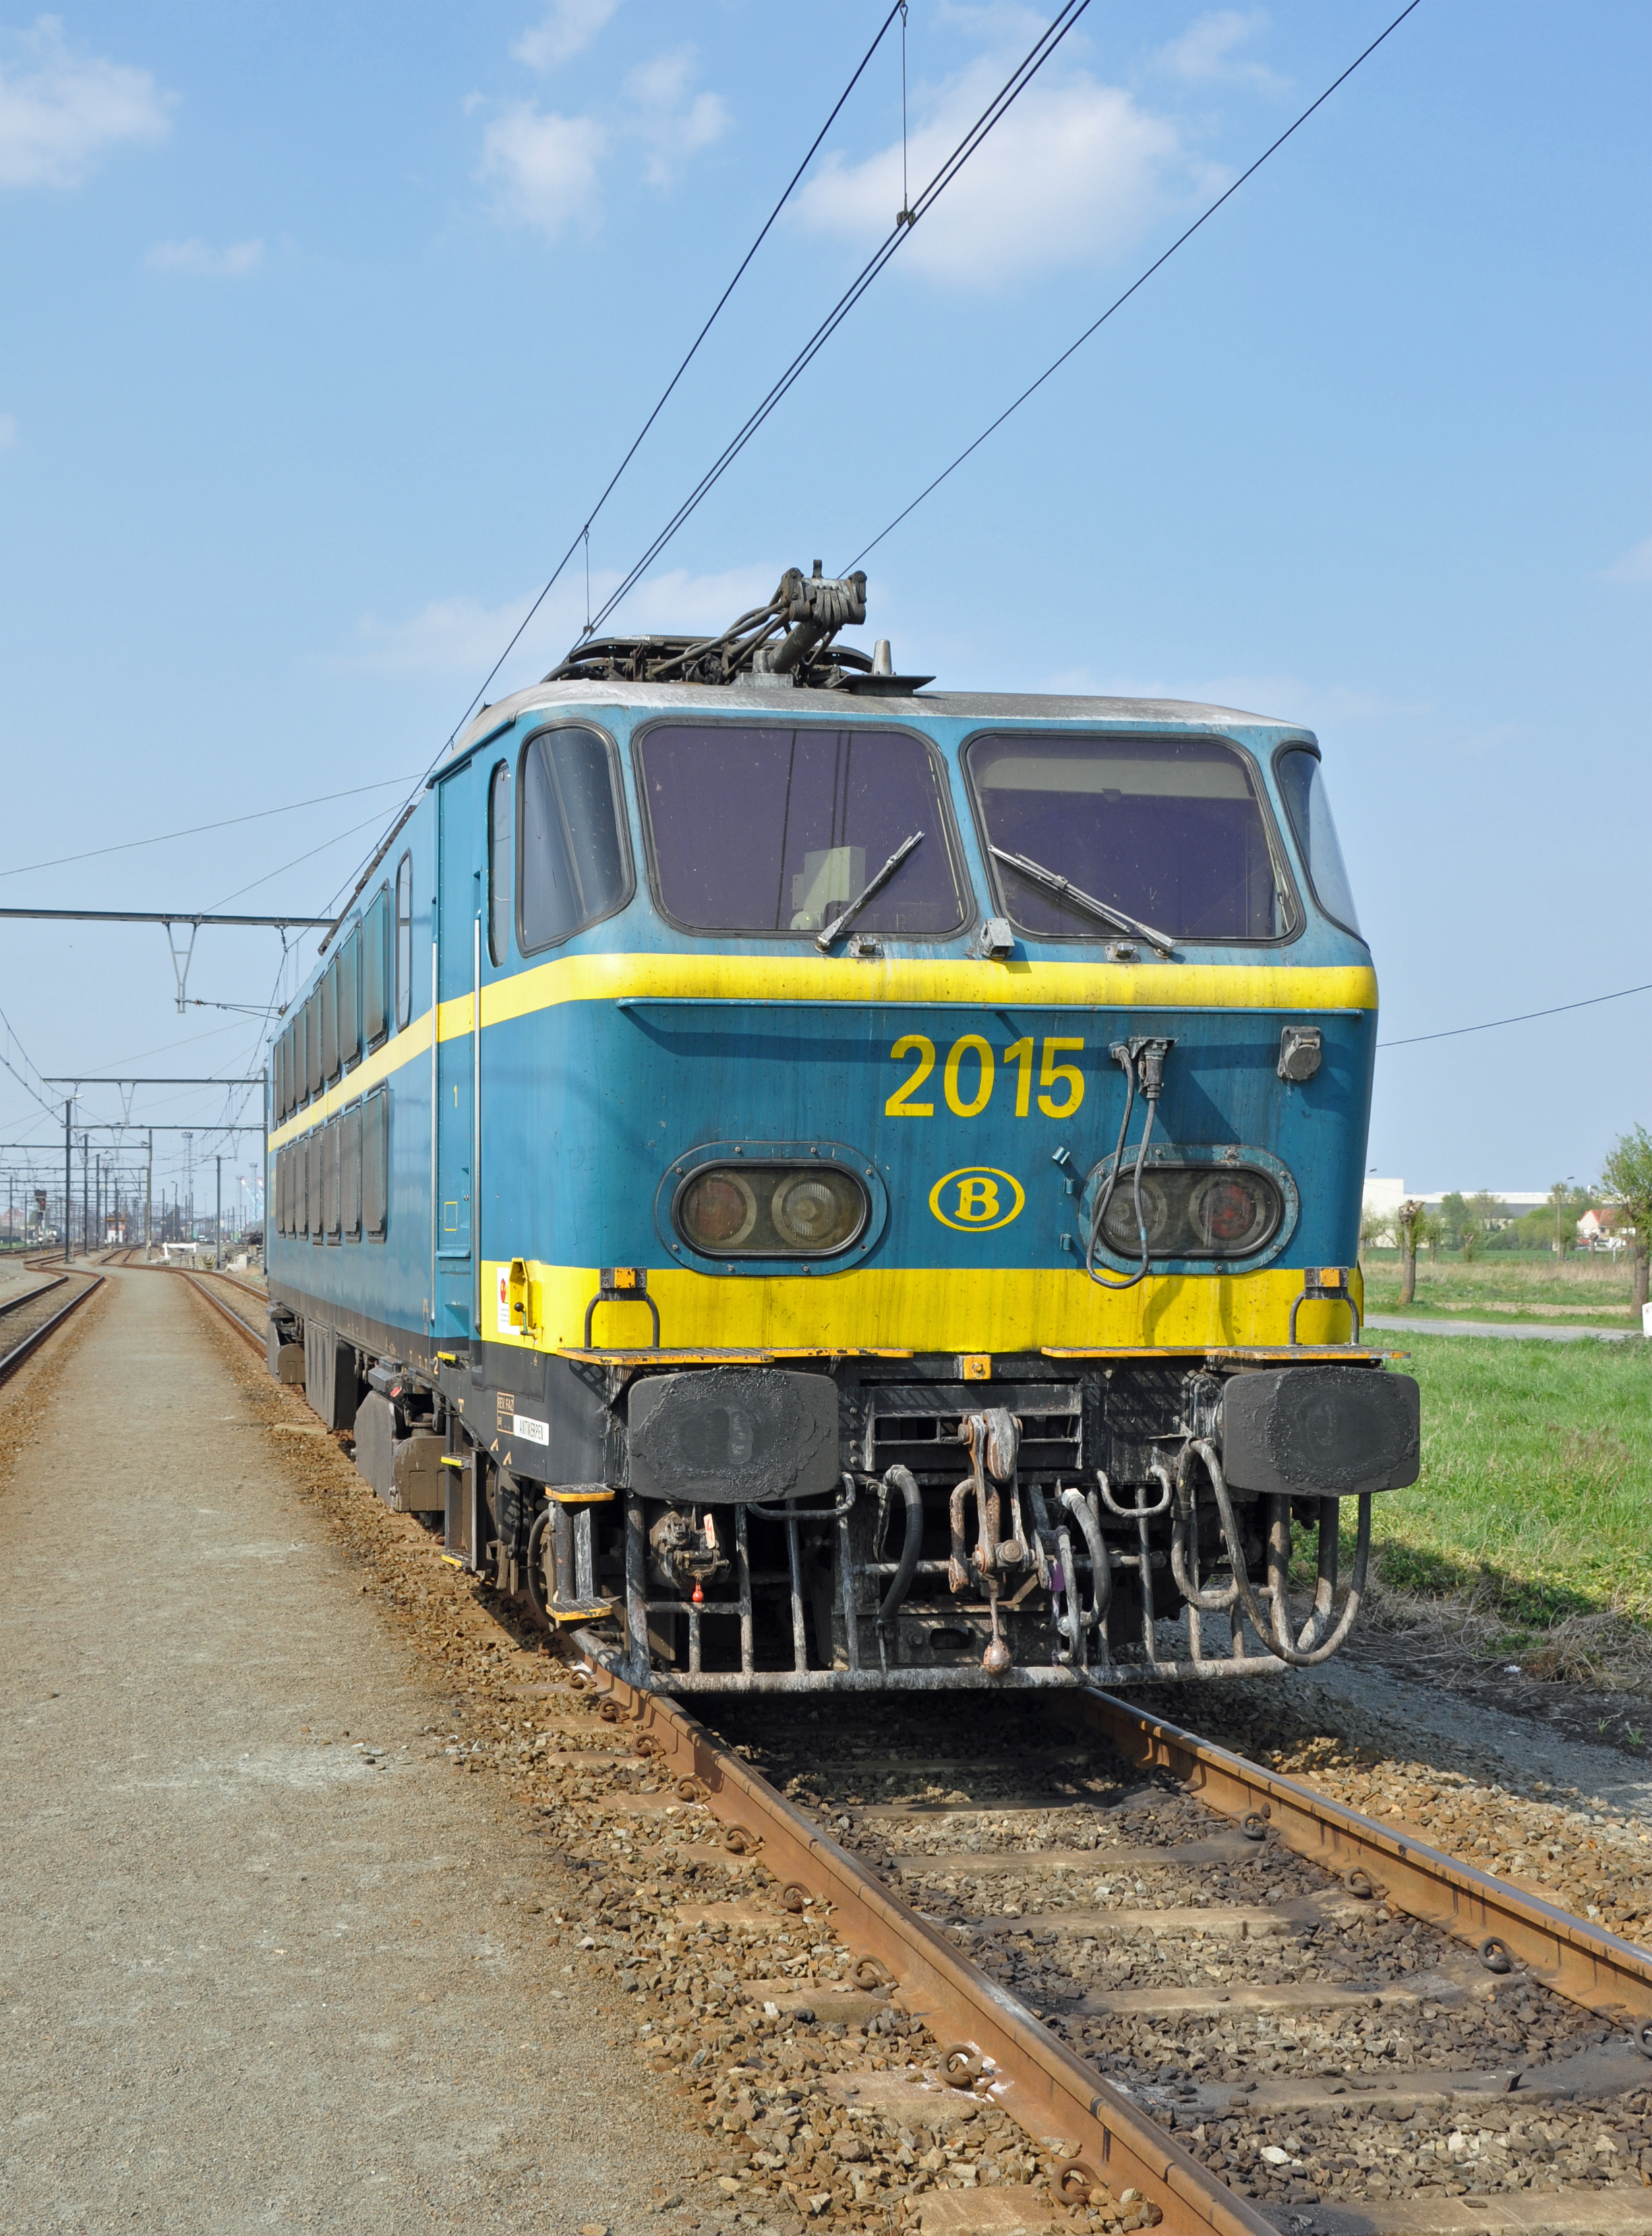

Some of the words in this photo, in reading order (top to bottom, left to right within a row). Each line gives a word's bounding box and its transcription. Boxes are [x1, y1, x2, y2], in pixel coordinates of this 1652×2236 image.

[885, 1034, 1085, 1119] 2015
[433, 1356, 438, 1374] 2
[519, 1419, 543, 1440] ANTWERPEN
